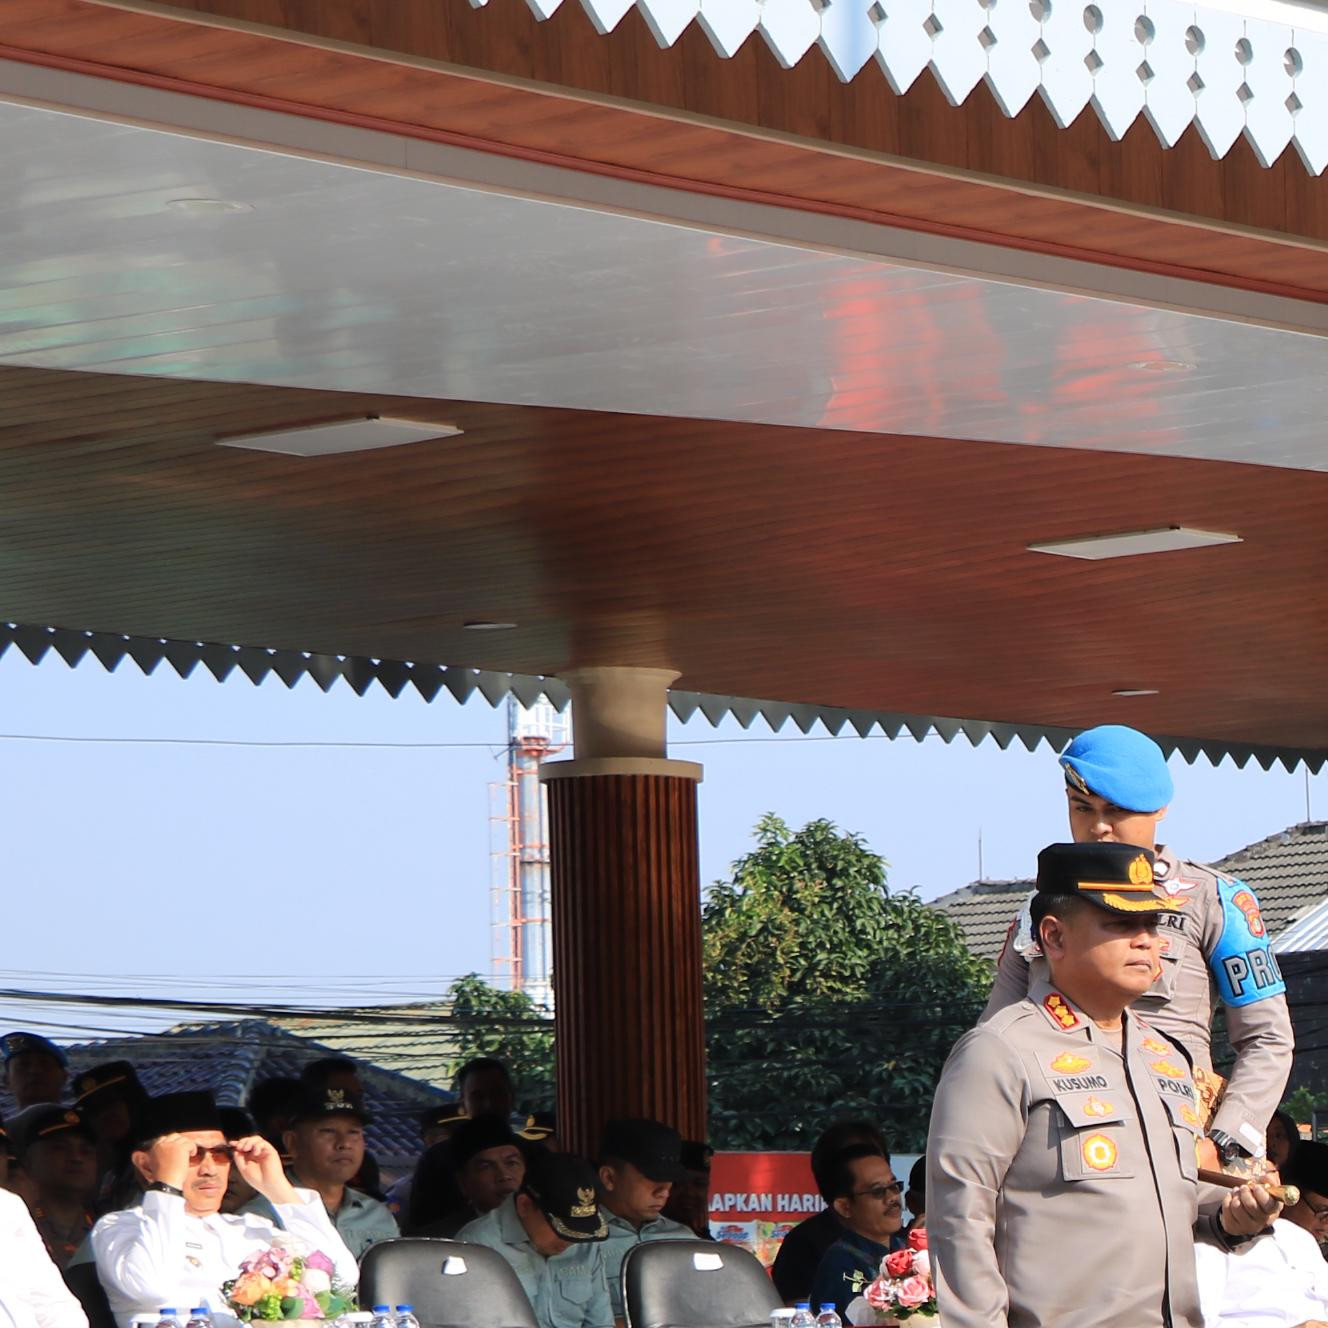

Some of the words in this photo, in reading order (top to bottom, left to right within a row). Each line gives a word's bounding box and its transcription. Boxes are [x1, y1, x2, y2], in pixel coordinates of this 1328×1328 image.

[1157, 911, 1186, 931] LRI
[1052, 1075, 1108, 1092] KUSUMO
[708, 1193, 773, 1212] APKAN
